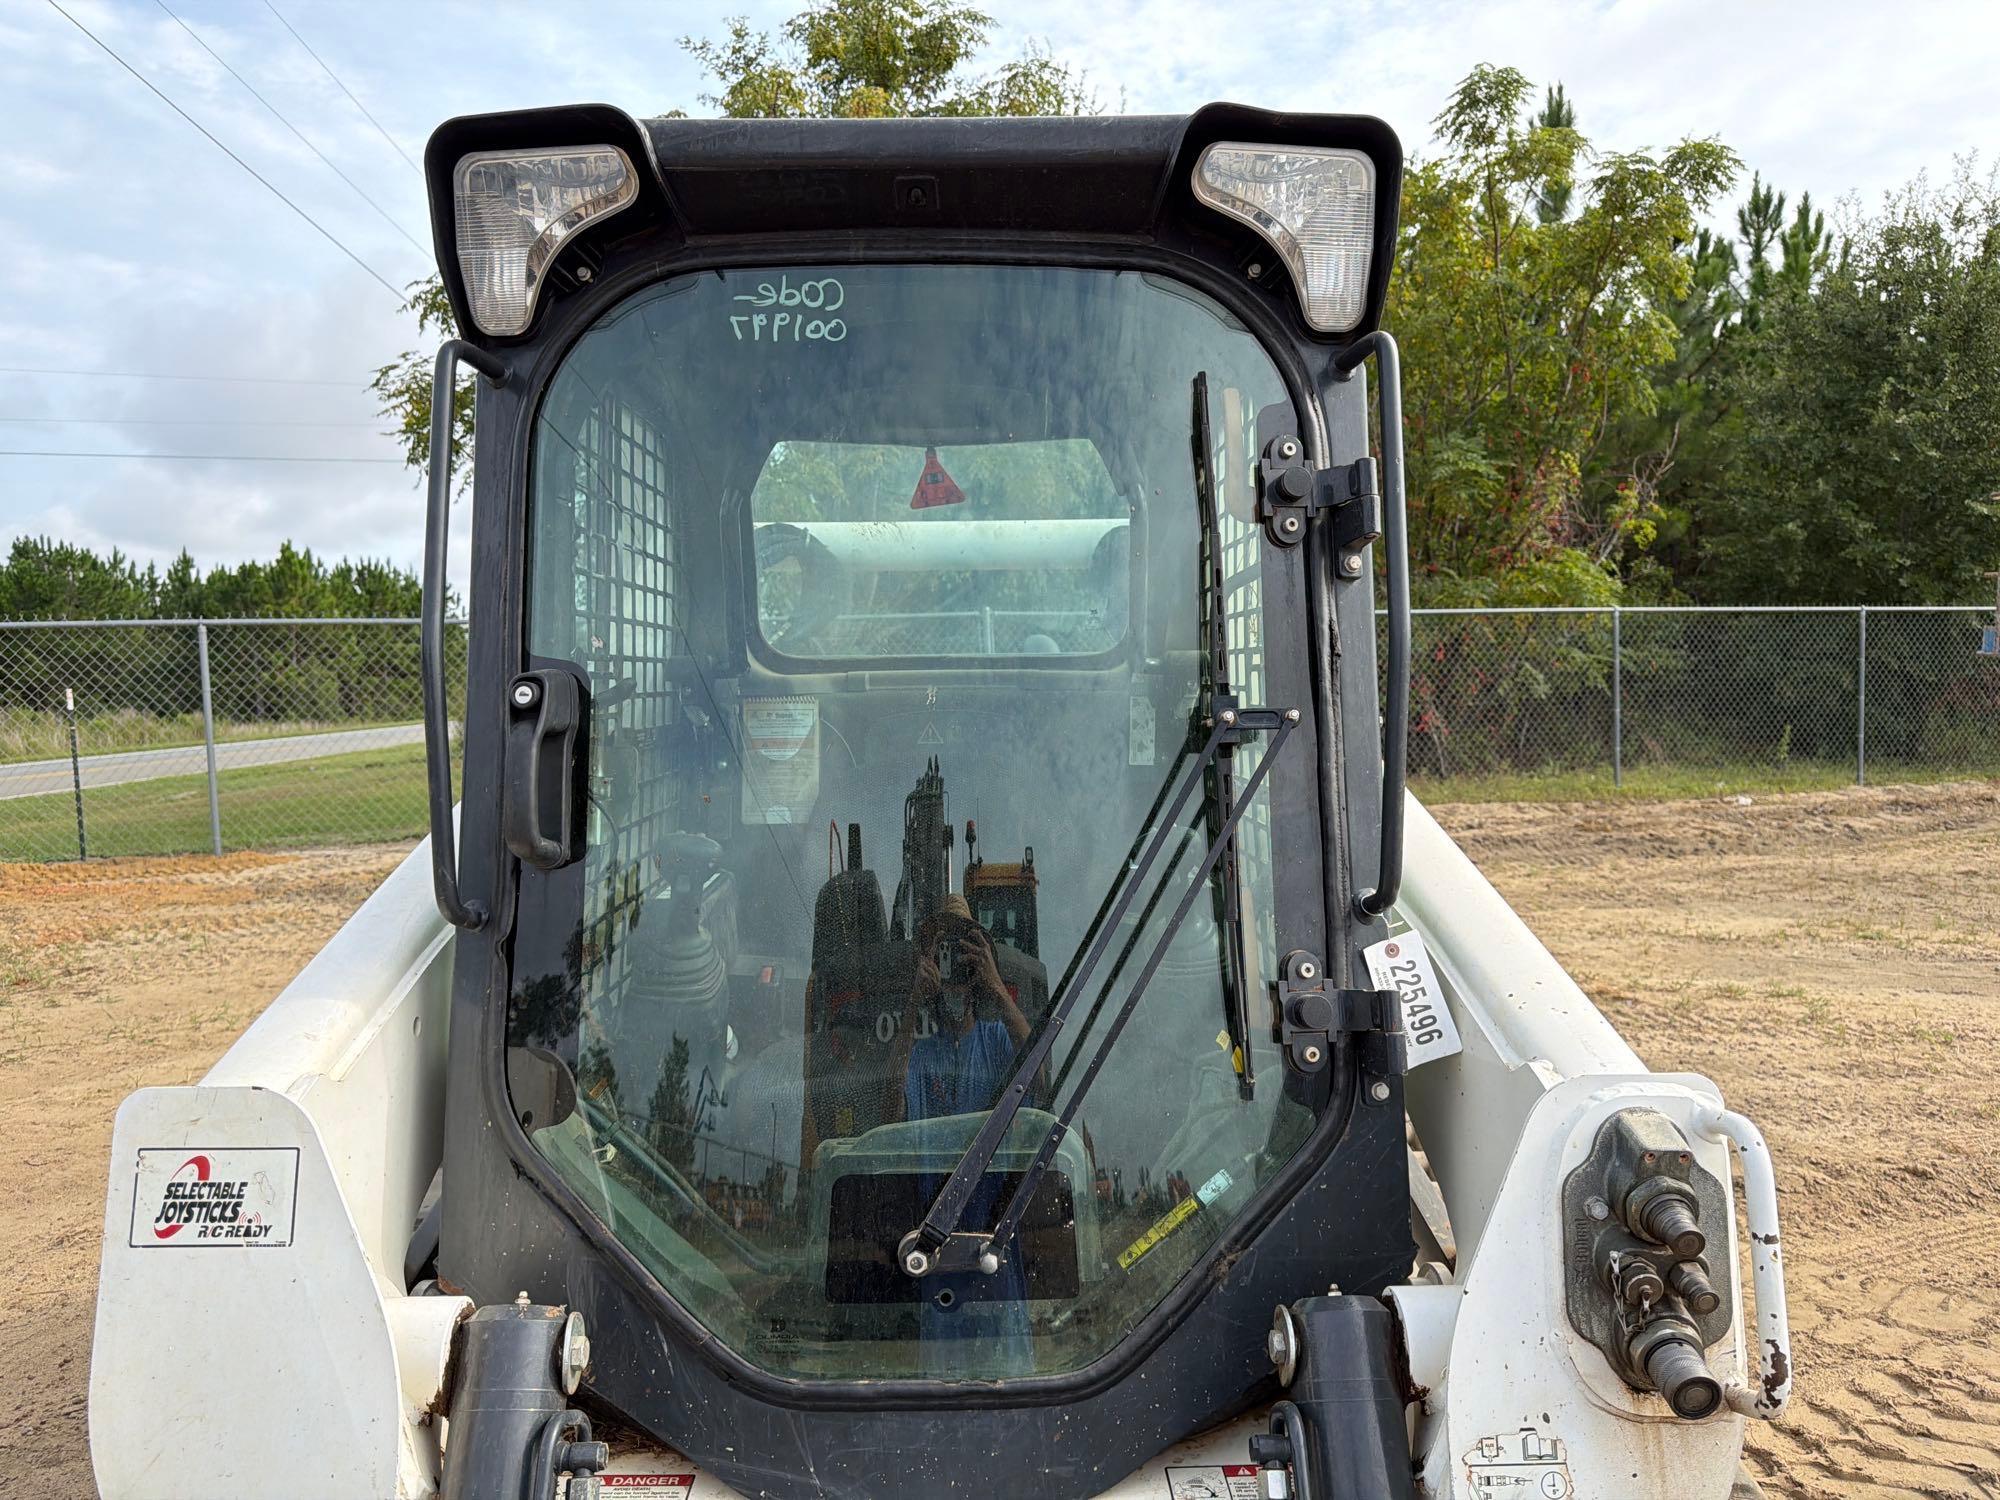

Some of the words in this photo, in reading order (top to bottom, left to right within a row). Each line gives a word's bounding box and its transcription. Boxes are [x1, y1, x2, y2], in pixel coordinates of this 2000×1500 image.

[1389, 960, 1443, 1046] 225496
[164, 1181, 248, 1200] SELECTABLE
[154, 1201, 243, 1224] JOYSTICKS
[197, 1225, 224, 1238] R/C
[224, 1225, 273, 1238] READY
[612, 1476, 680, 1485] DANGER
